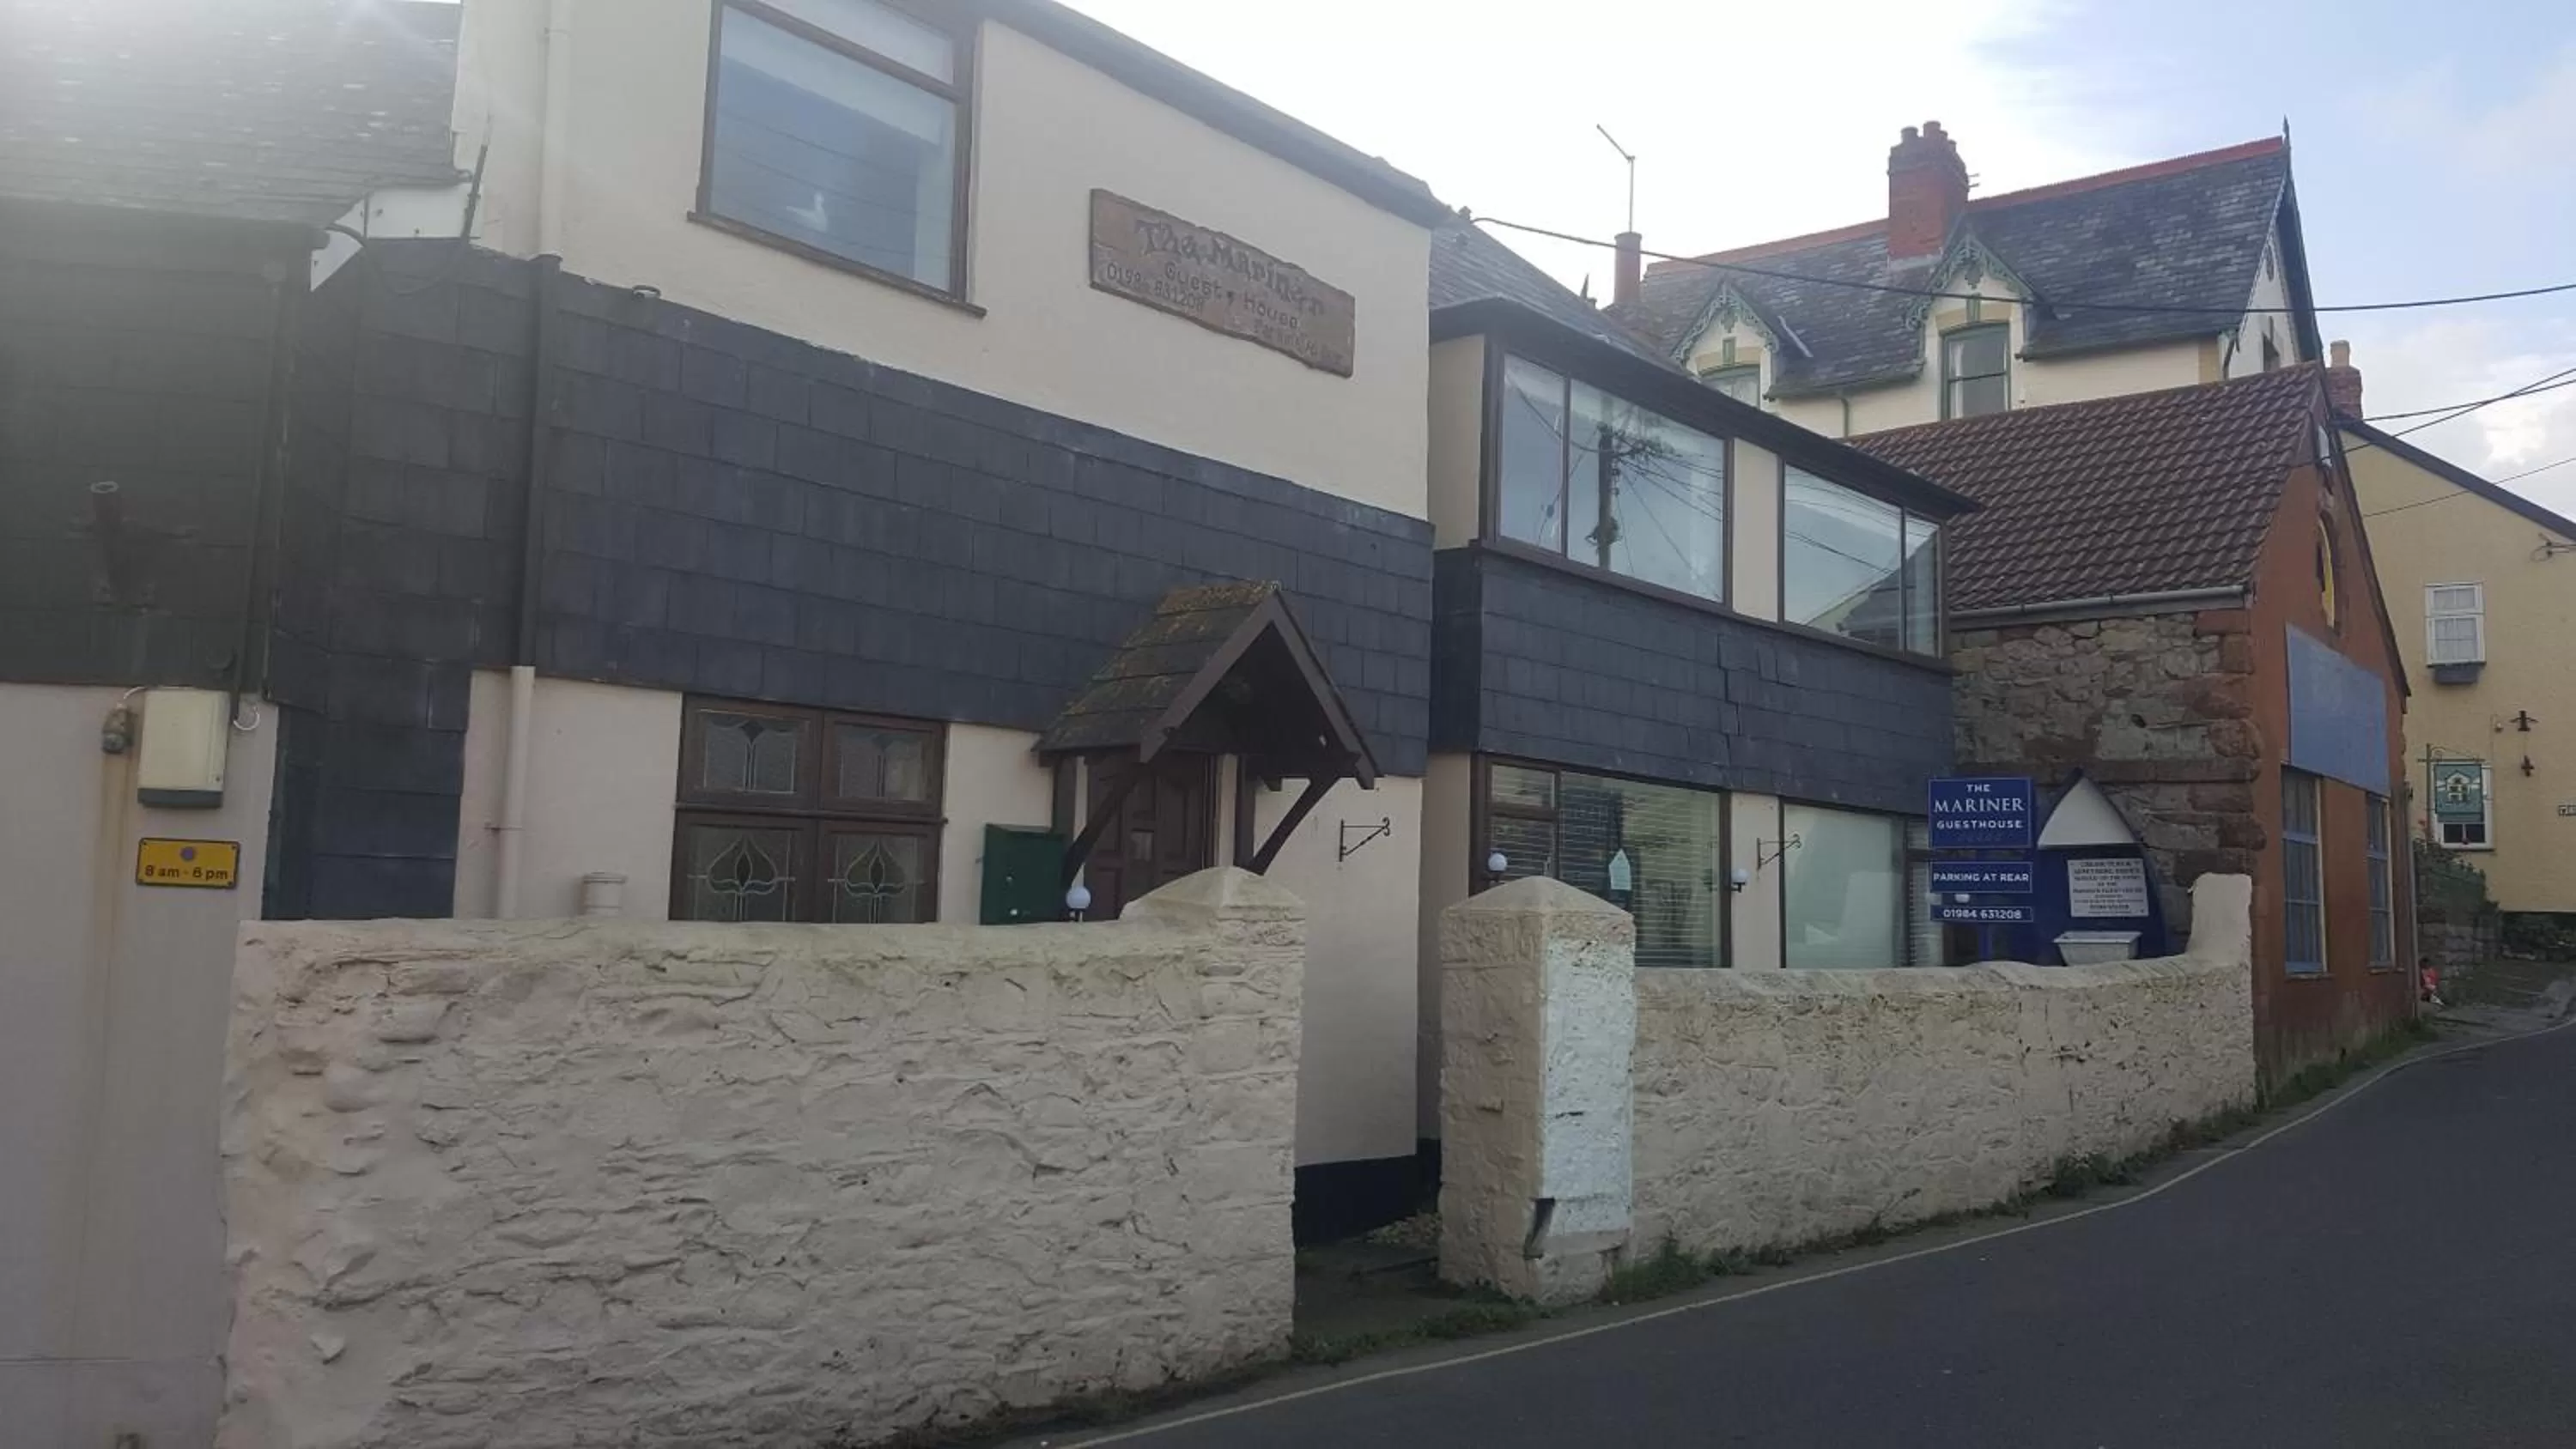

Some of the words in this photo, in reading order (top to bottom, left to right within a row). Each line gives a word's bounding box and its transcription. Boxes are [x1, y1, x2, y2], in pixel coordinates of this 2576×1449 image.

[1966, 784, 1991, 792] THE
[1933, 797, 2026, 813] MARINER
[1936, 820, 2024, 830] GUESTHOUSE
[1933, 872, 1980, 882] PARKING
[2000, 872, 2029, 882] REAR
[1942, 909, 1978, 919] 01984
[1979, 909, 2022, 919] 631208
